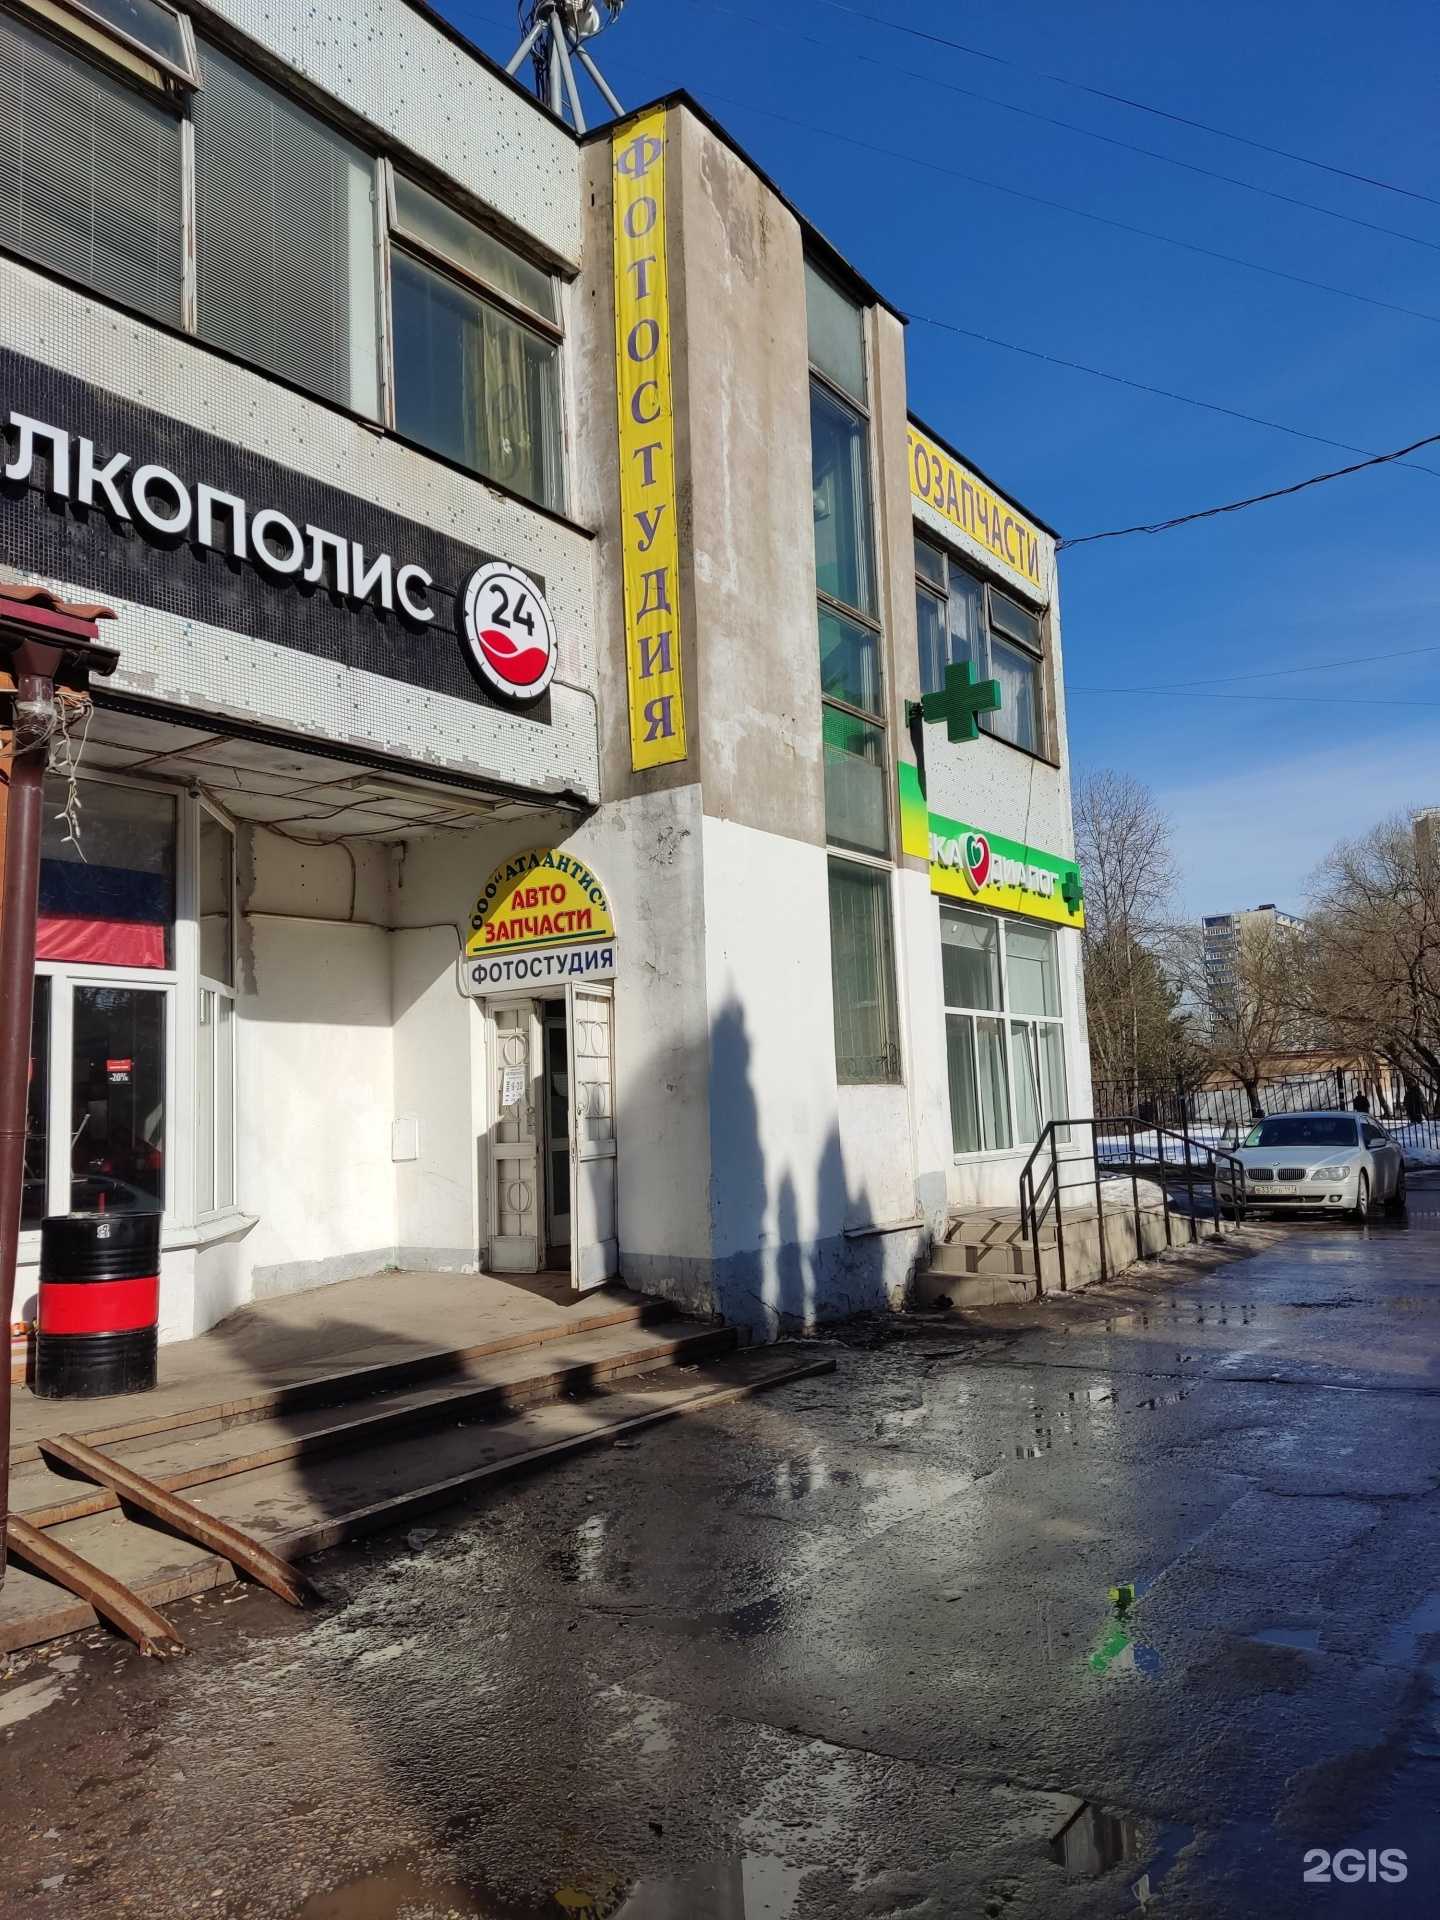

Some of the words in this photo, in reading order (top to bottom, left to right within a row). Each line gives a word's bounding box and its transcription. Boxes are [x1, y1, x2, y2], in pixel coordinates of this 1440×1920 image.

[617, 133, 676, 742] ФОТОСТУДИЯ
[489, 584, 535, 637] 24
[511, 883, 566, 910] АВТО
[485, 908, 592, 943] ЗАПЧАСТИ
[471, 948, 613, 984] ФОТОСТУДИЯ
